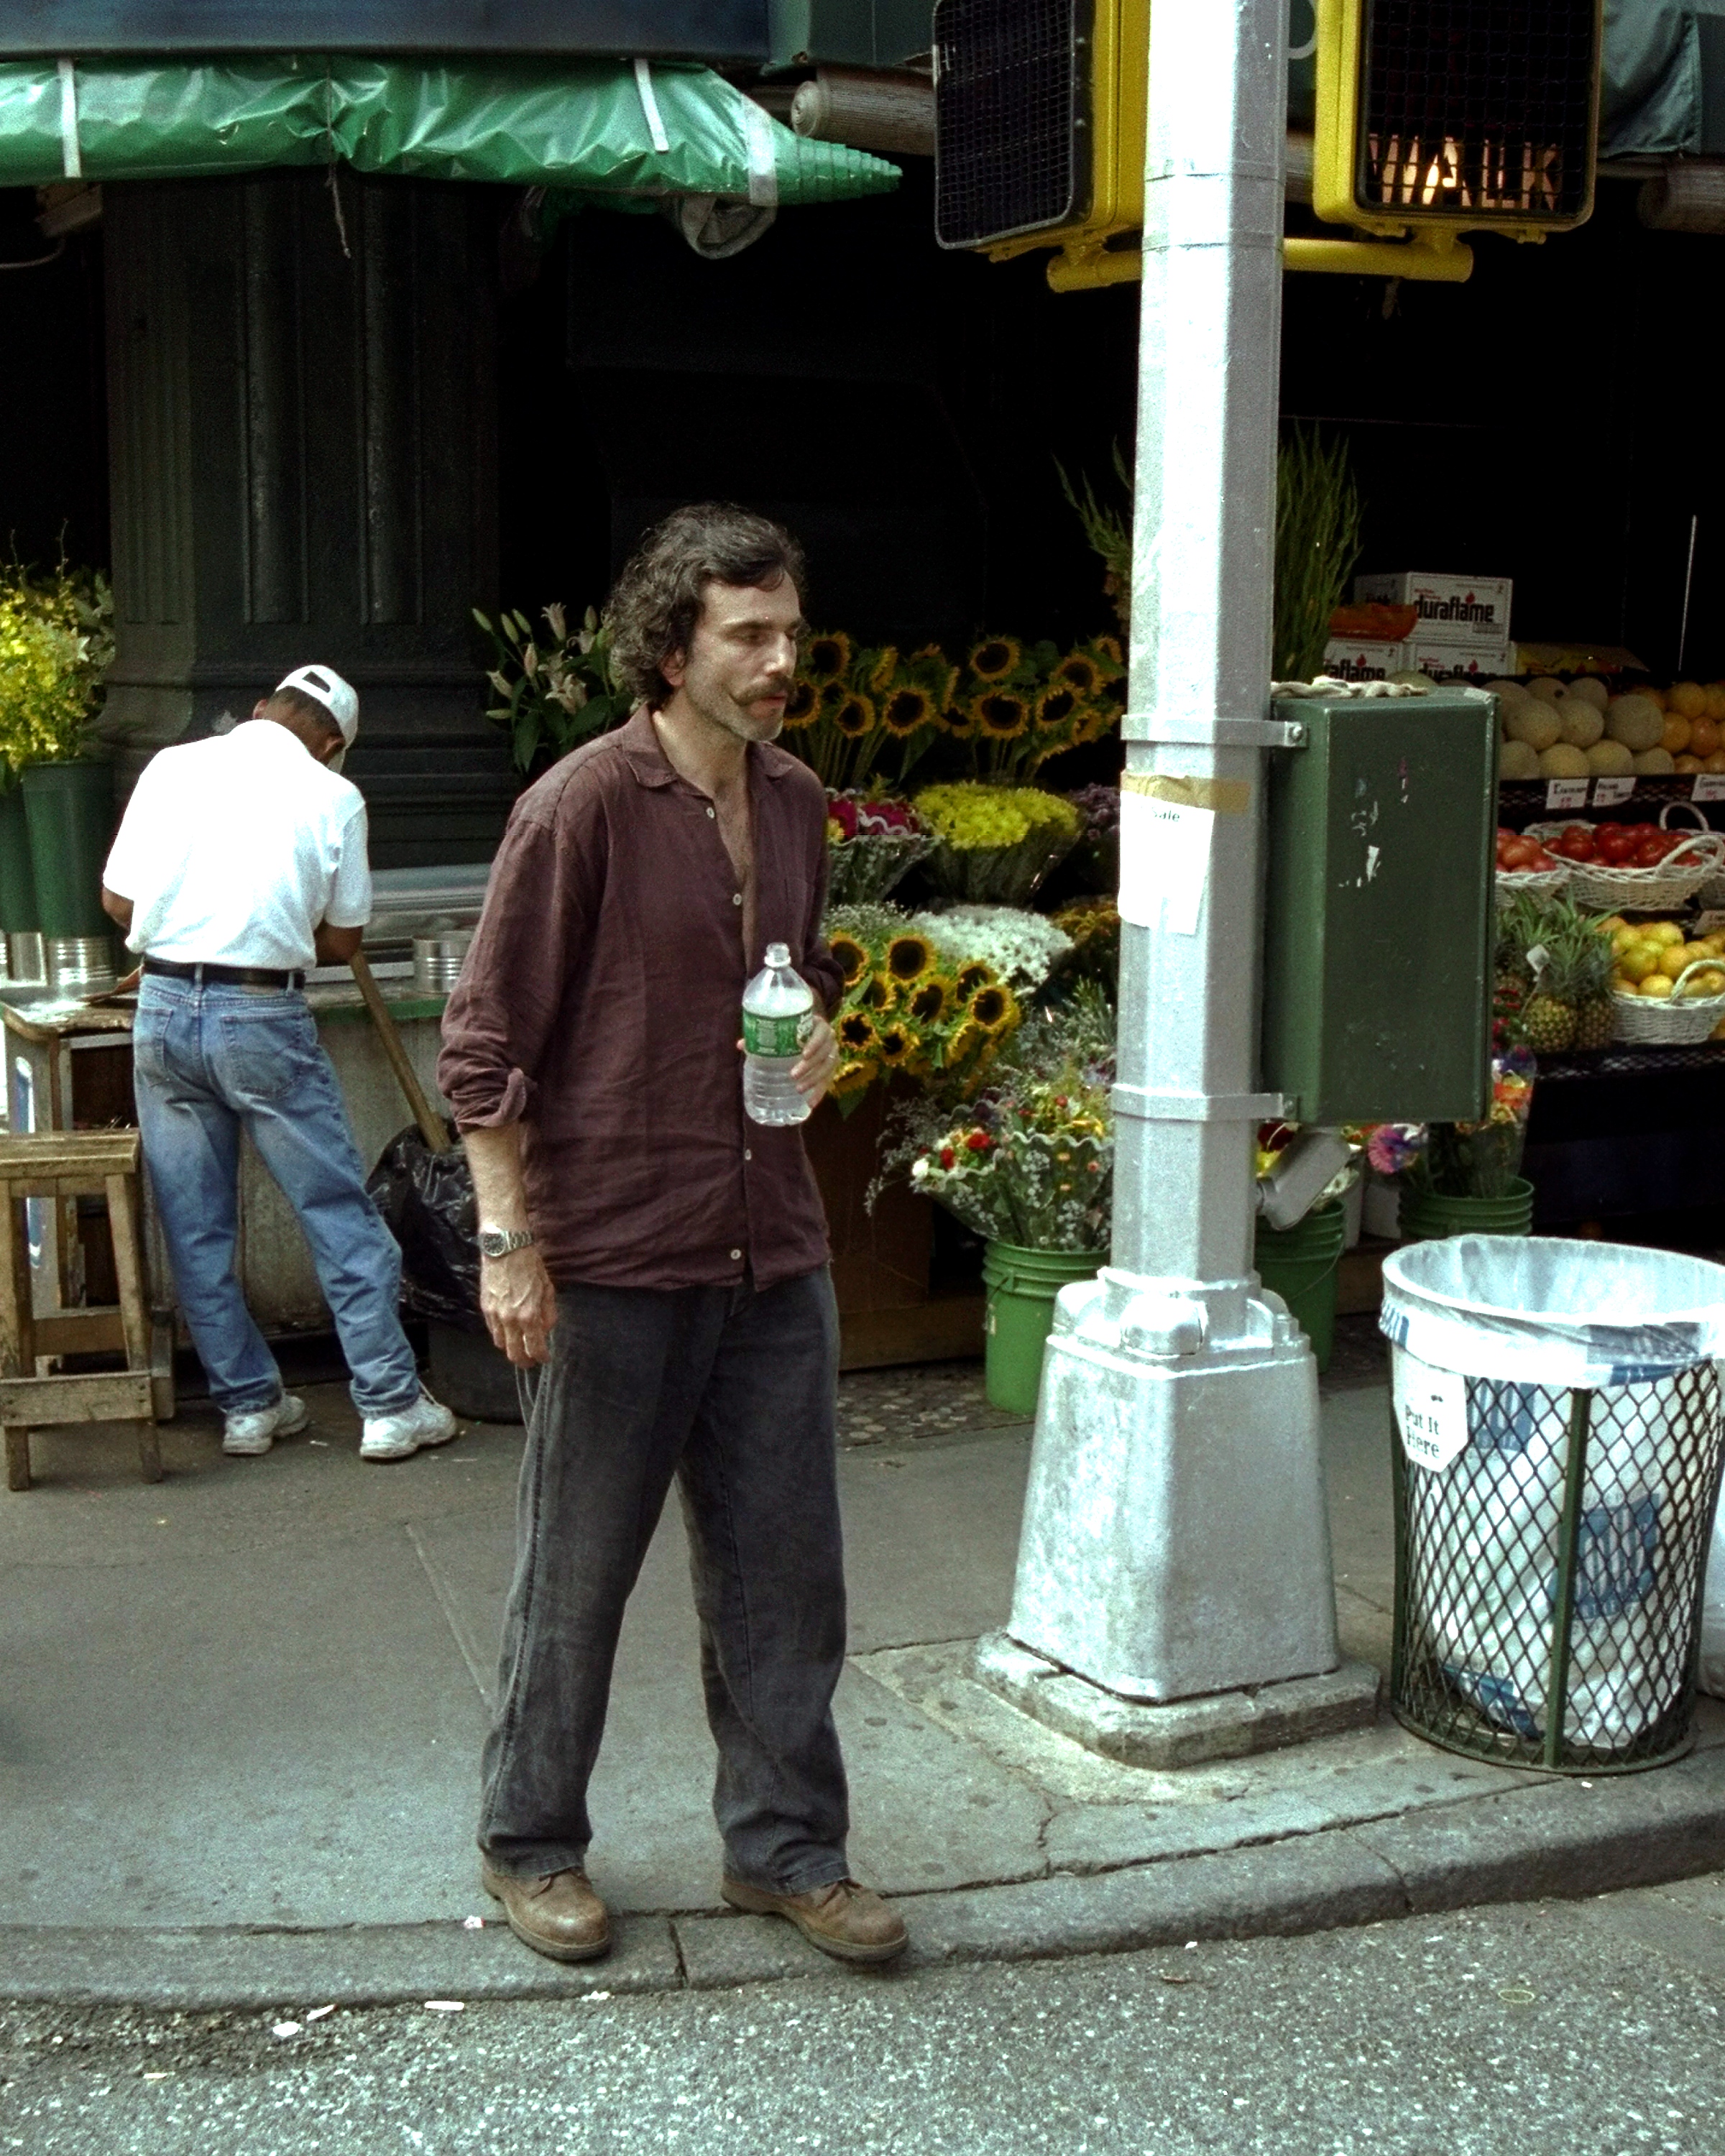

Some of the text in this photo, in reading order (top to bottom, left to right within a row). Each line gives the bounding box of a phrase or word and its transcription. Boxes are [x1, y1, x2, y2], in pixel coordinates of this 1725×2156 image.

[1368, 132, 1563, 210] WALK
[1413, 594, 1494, 622] duraflame
[1151, 806, 1181, 823] Sale
[1404, 1404, 1440, 1435] Put It
[1406, 1425, 1440, 1459] Here
